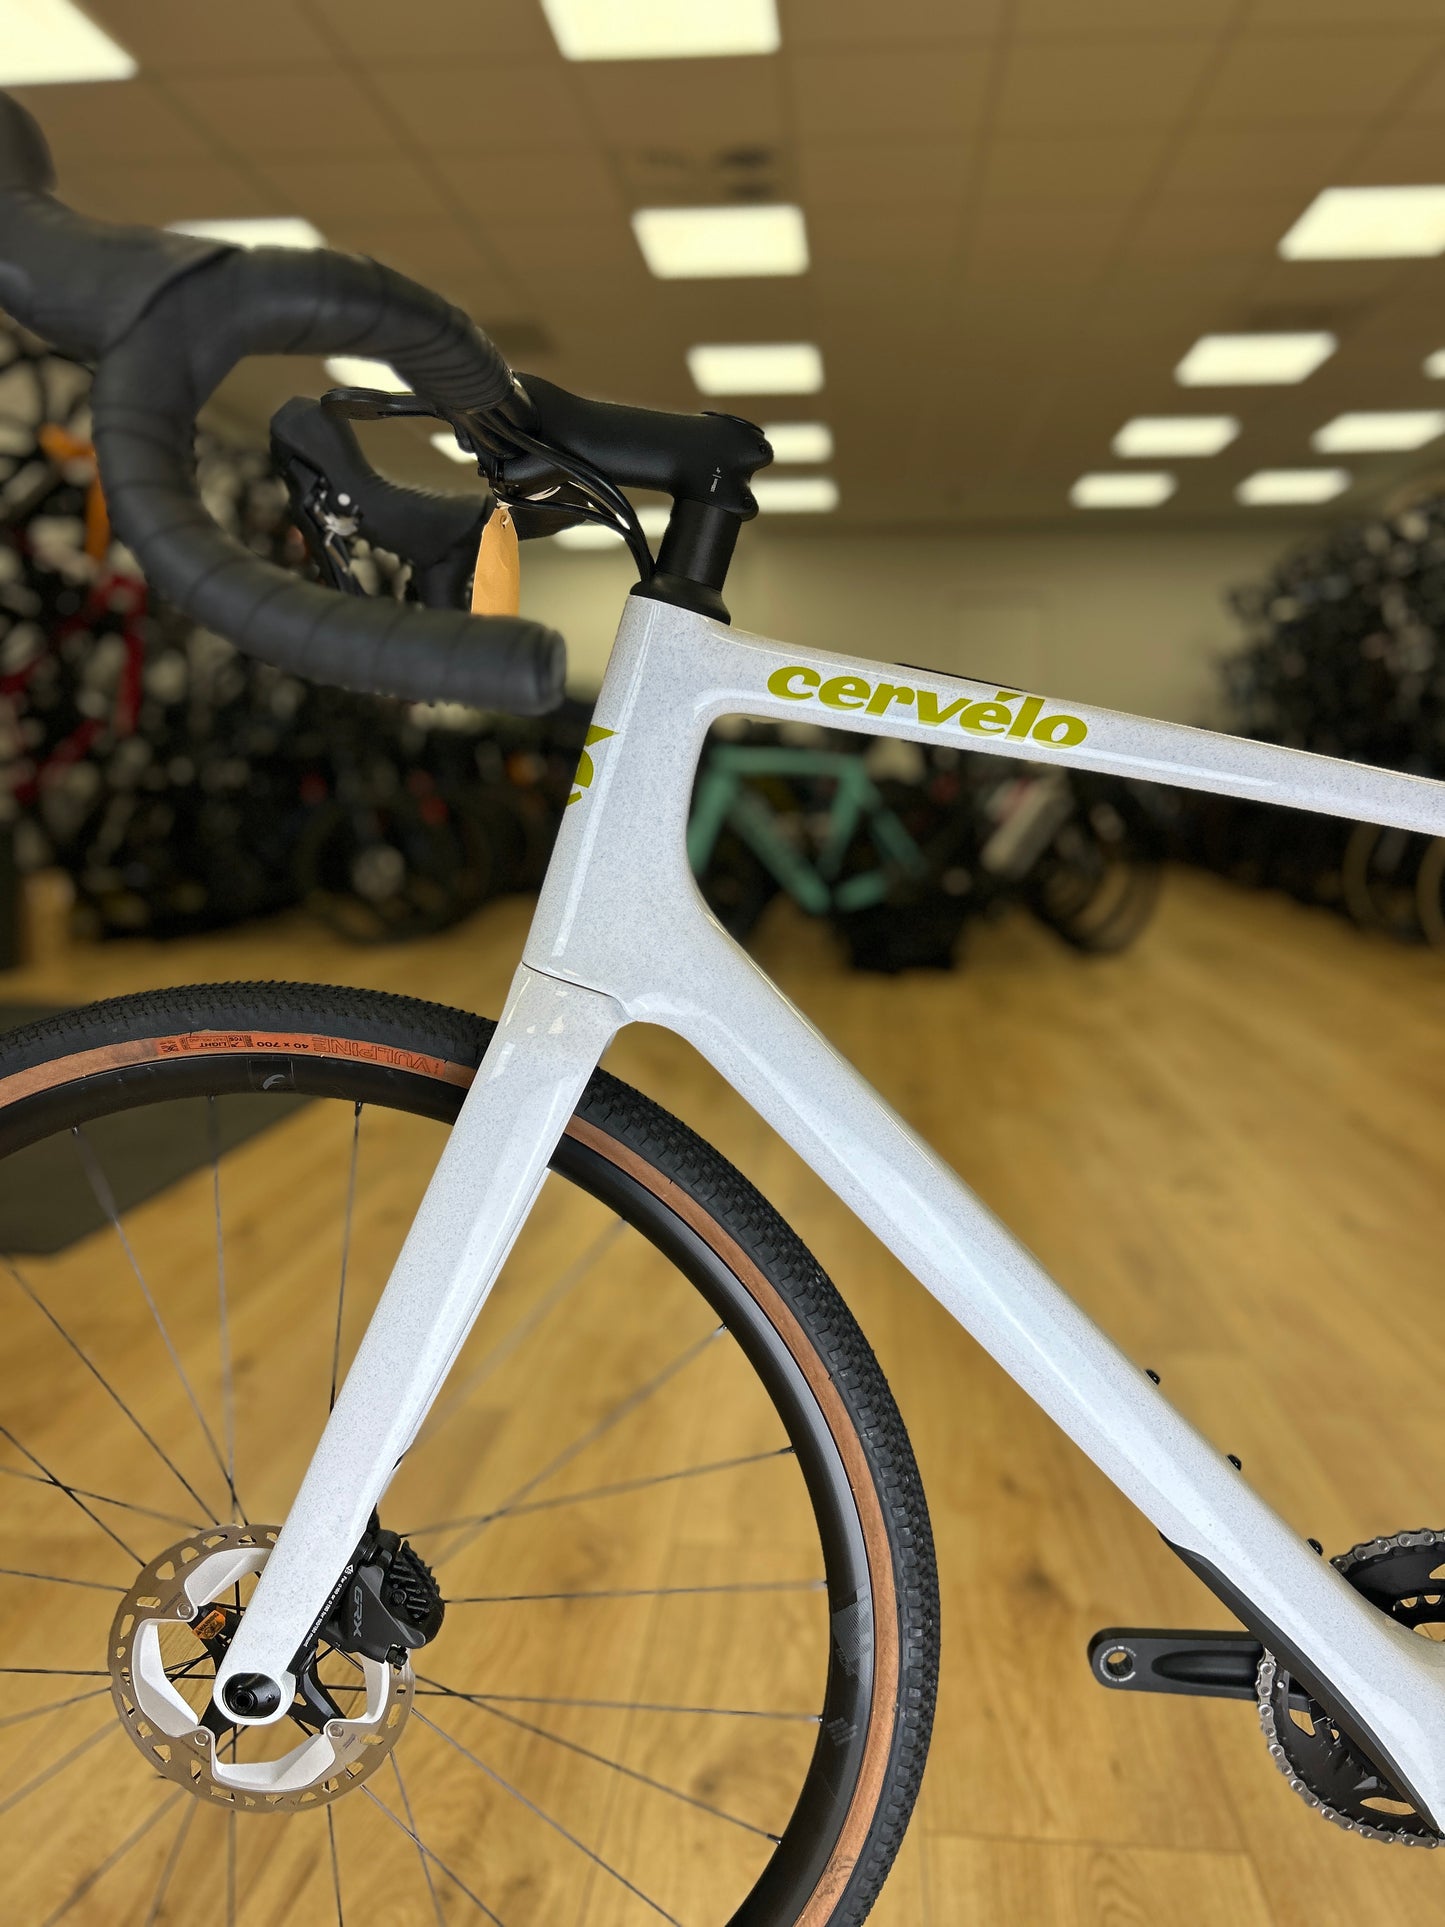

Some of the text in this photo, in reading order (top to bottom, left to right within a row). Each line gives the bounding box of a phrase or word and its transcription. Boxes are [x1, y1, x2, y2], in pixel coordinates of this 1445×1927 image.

[767, 666, 1088, 750] cervélo
[312, 1037, 431, 1073] VULPINE
[354, 1586, 363, 1637] GRX
